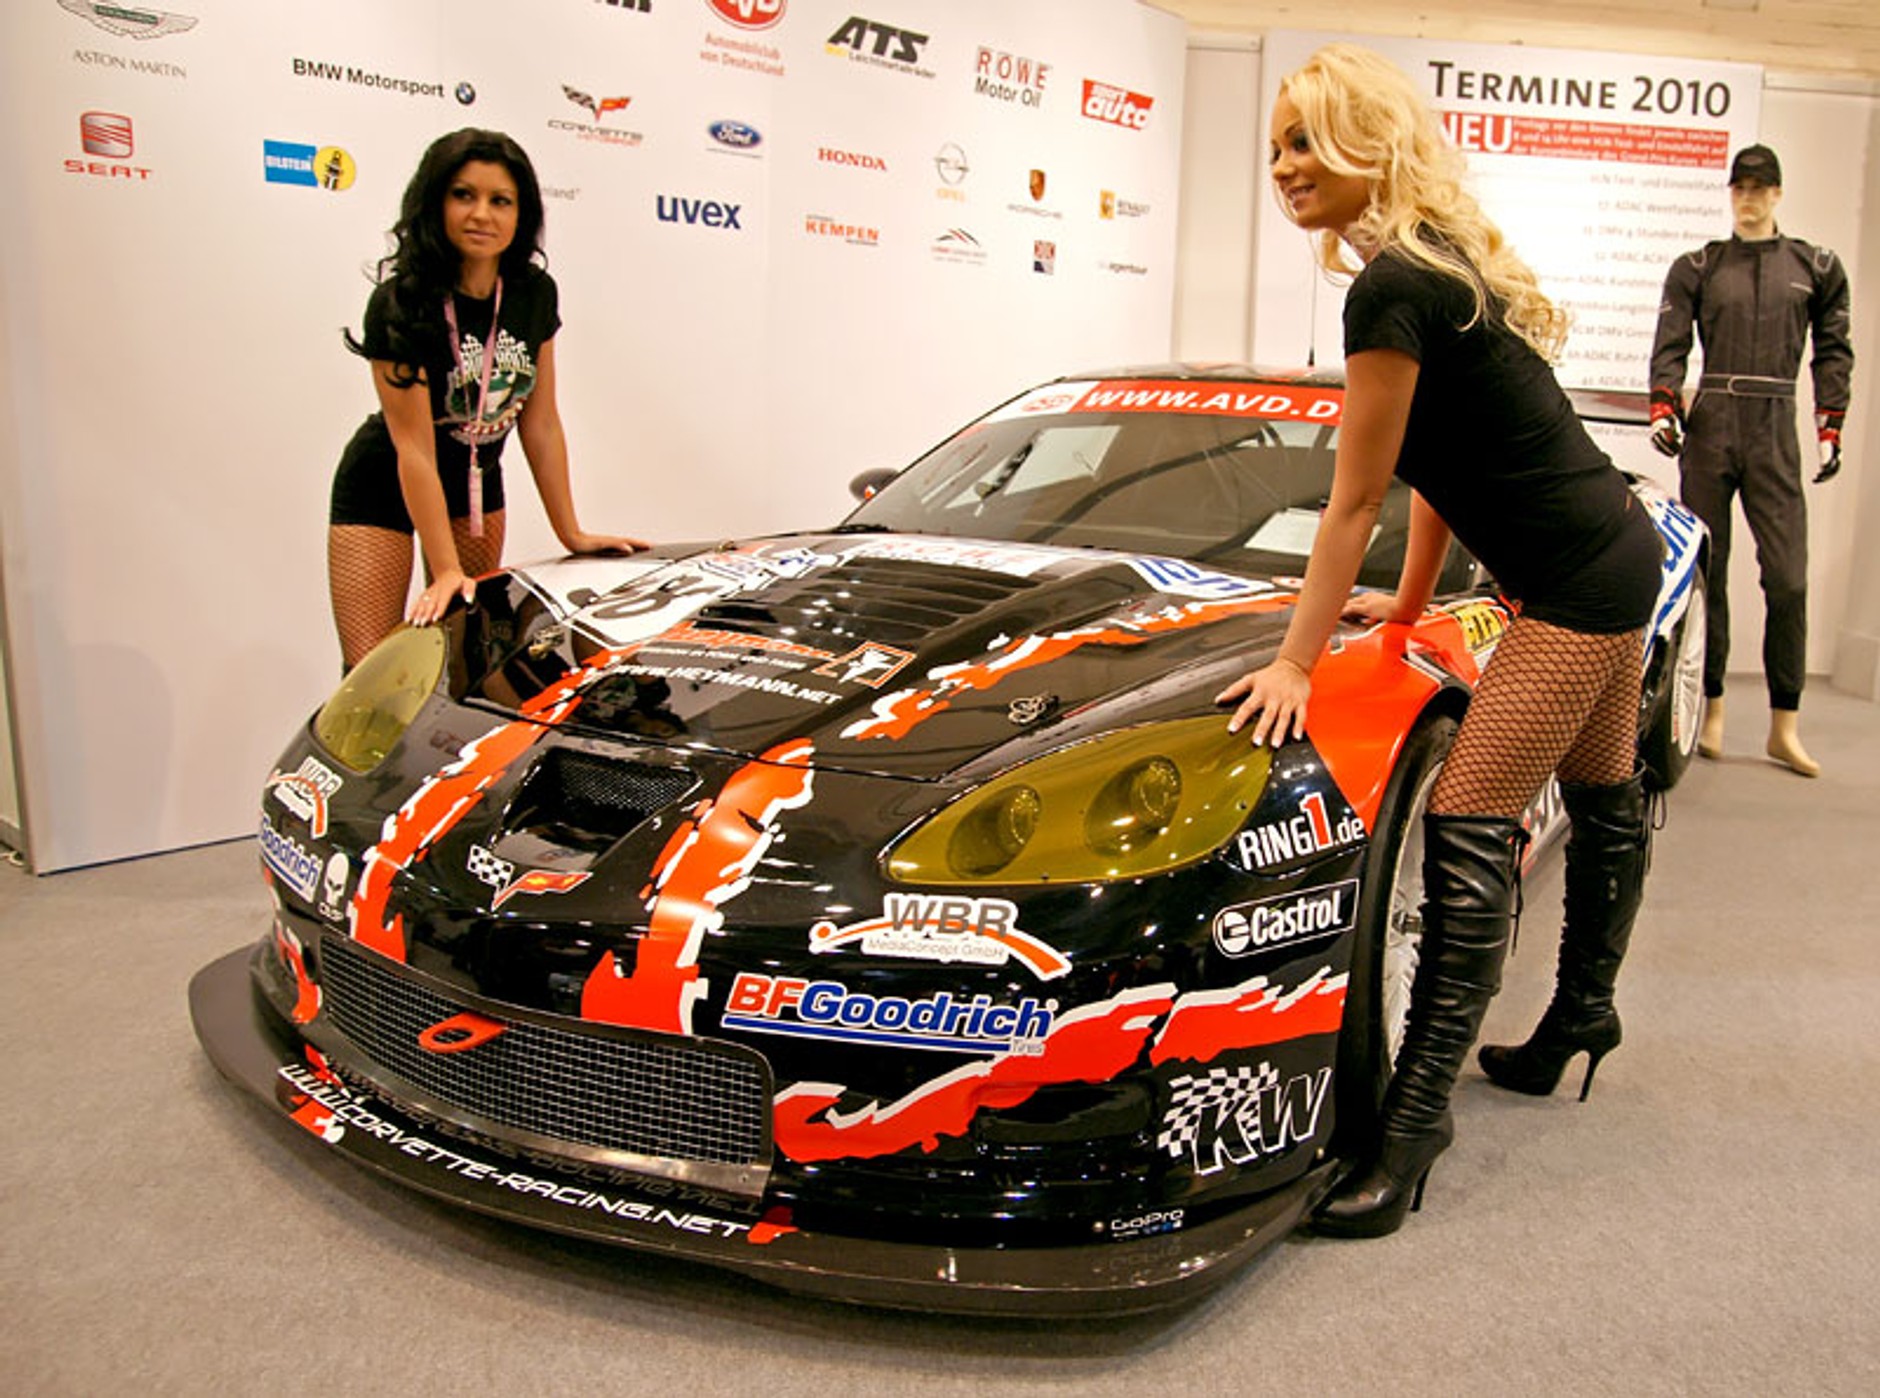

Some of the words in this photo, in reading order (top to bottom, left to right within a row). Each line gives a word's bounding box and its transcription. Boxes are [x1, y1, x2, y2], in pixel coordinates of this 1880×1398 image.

[826, 15, 930, 64] ATS
[74, 50, 126, 69] ASTON
[130, 59, 187, 78] MARTIN
[292, 58, 342, 83] BMW
[346, 68, 445, 98] Motorsport
[974, 46, 1052, 91] ROWE
[974, 76, 1018, 105] Motor
[1021, 85, 1042, 109] Oil
[1631, 75, 1732, 118] 2010
[1085, 94, 1151, 128] auto
[548, 121, 643, 141] CORVETTE
[714, 122, 755, 146] Ford
[1440, 112, 1512, 153] NEU
[63, 158, 154, 180] SEAT
[818, 147, 888, 172] HONDA
[655, 194, 742, 229] uvex
[805, 220, 879, 242] KEMPEN
[1085, 390, 1344, 419] WWW.AVD.D
[889, 896, 1013, 938] WBR
[1250, 889, 1343, 947] Castrol
[725, 973, 1052, 1039] BFGoodrich
[1192, 1066, 1333, 1176] KW
[1110, 1208, 1185, 1231] GoPro
